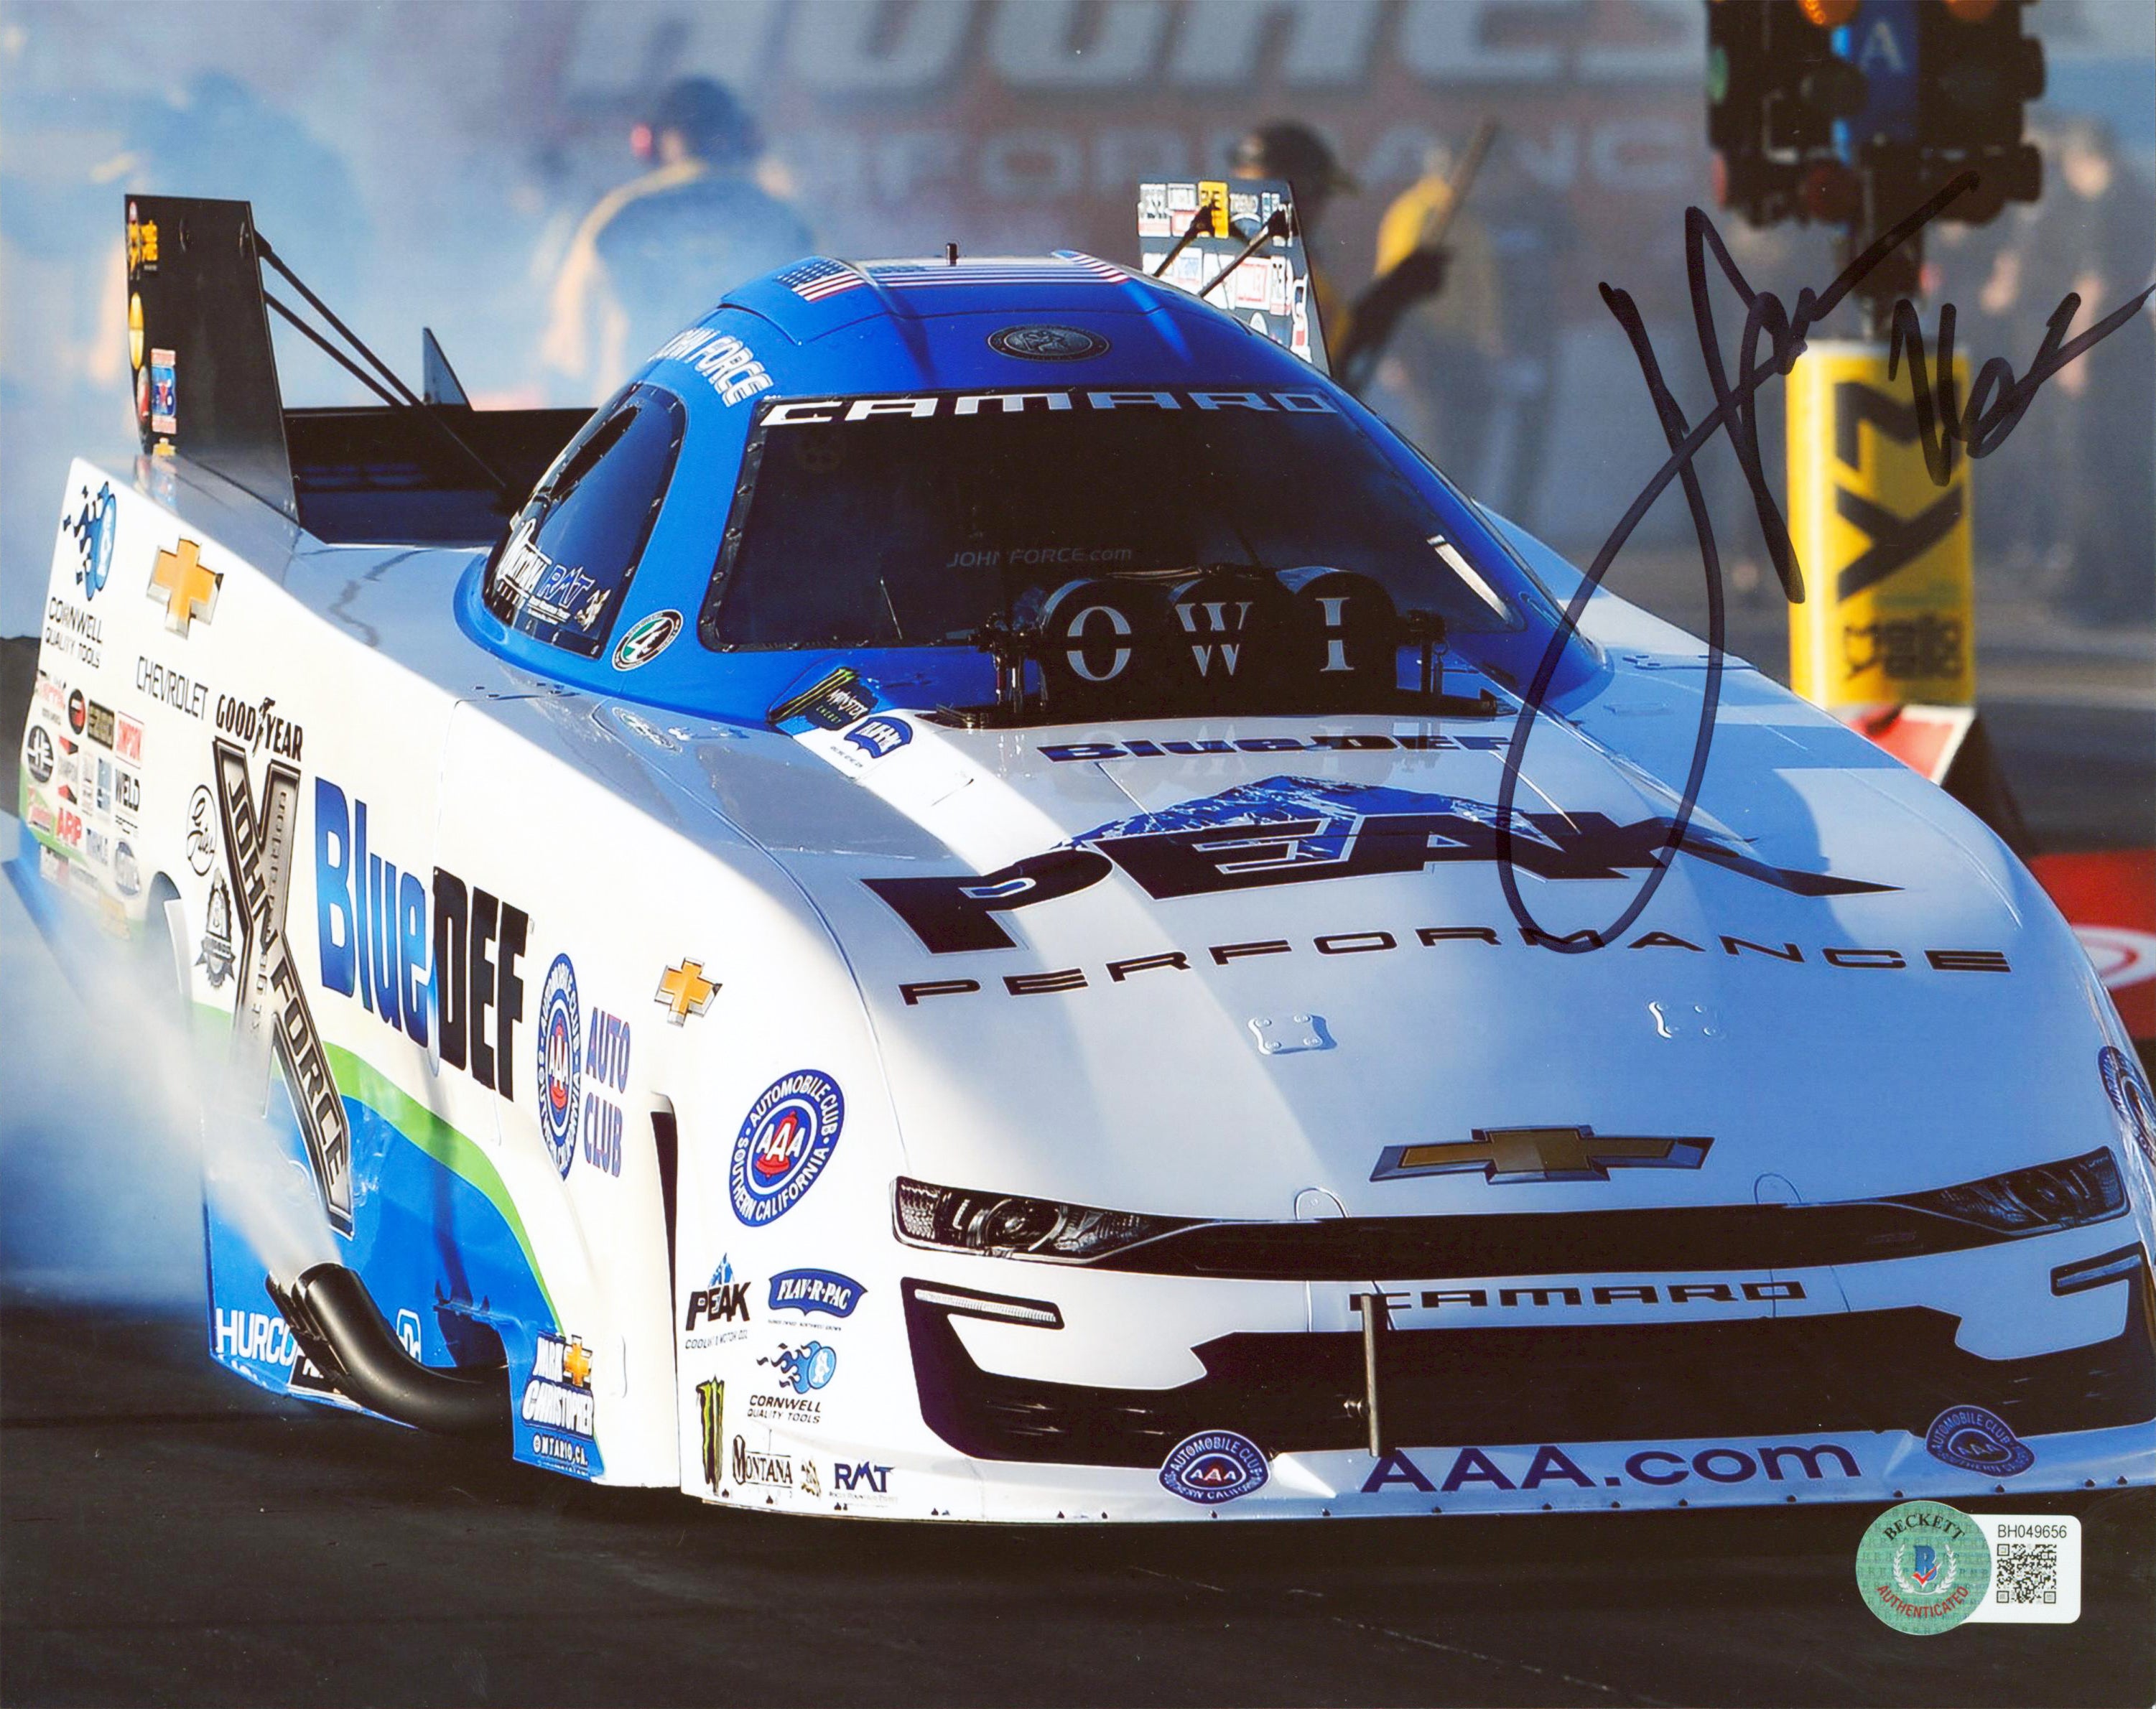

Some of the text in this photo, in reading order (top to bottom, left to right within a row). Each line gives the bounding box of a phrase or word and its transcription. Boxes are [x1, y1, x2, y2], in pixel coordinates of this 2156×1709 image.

[684, 335, 774, 408] FORCE
[759, 391, 1340, 427] CAMARO
[49, 597, 103, 643] CORNWELL
[136, 655, 209, 720] CHEVROLET
[860, 811, 1905, 954] PEAK
[228, 779, 279, 955] JOHN
[271, 956, 344, 1185] FORCE
[899, 926, 2012, 1005] PERFORMANCE
[548, 1034, 570, 1091] AAA
[585, 1006, 631, 1094] AUTO
[750, 1075, 839, 1136] AUTOMOBILE CLUB
[583, 1091, 623, 1178] CLUB
[756, 1122, 806, 1163] AAA
[733, 1137, 830, 1221] SOUTHERN CALIFORNIA
[685, 1281, 752, 1331] PEAK
[1349, 1280, 1807, 1313] CAMARO
[747, 1408, 821, 1424] QUALITY TOOLS
[749, 1394, 822, 1414] CORNWELL
[1170, 1436, 1241, 1472] AUTOMOBILE
[1932, 1412, 2011, 1450] AUTOMOBILE CLUB
[834, 1461, 896, 1493] RMT
[1189, 1468, 1237, 1482] AAA
[1360, 1443, 1862, 1494] AAA.com
[1882, 1513, 1966, 1542] BECKETT
[1997, 1524, 2068, 1539] BH049656
[1877, 1584, 1970, 1619] AUTHENTICATED
